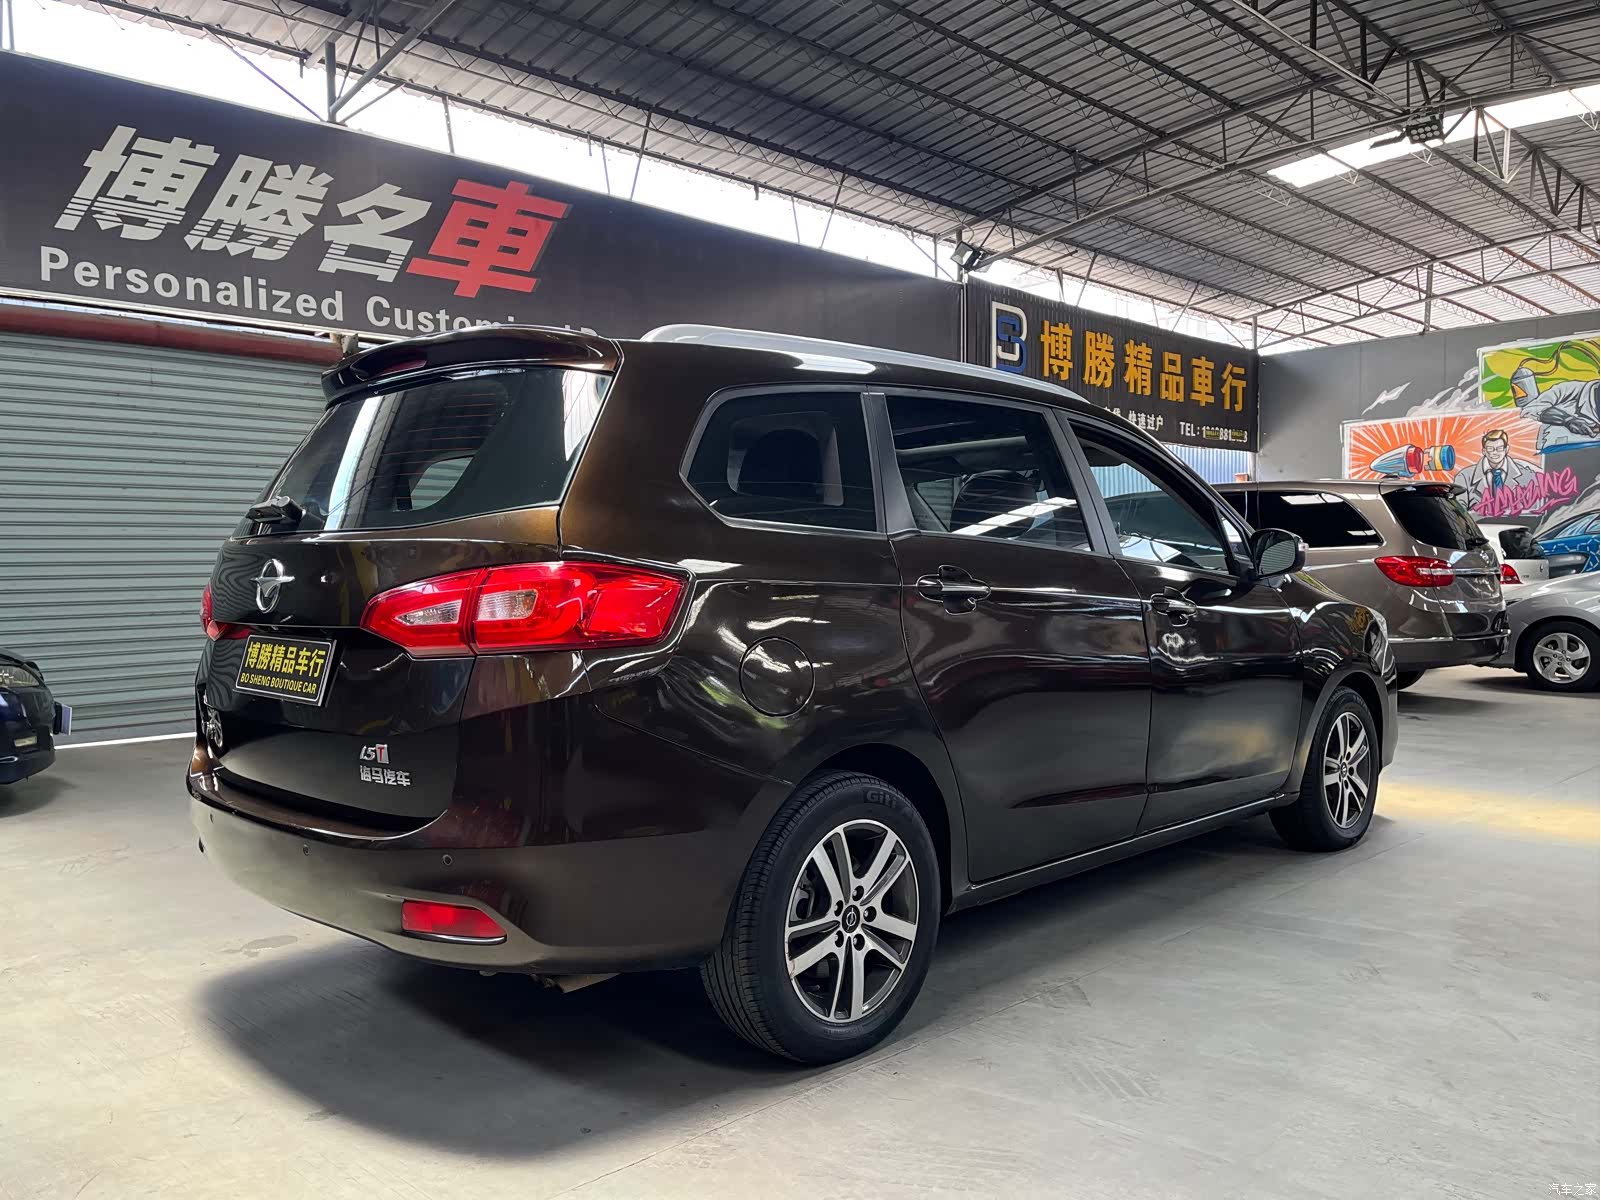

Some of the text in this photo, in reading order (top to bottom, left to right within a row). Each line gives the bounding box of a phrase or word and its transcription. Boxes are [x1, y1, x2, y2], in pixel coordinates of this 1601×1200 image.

[54, 125, 571, 298] 博勝名車
[39, 246, 344, 322] Personalized
[1040, 320, 1247, 412] 博勝精品車行
[1473, 466, 1580, 517] AMAZING
[240, 672, 317, 694] BO SHENG BOUTIQUE CAR
[245, 641, 326, 678] 博勝精品车行
